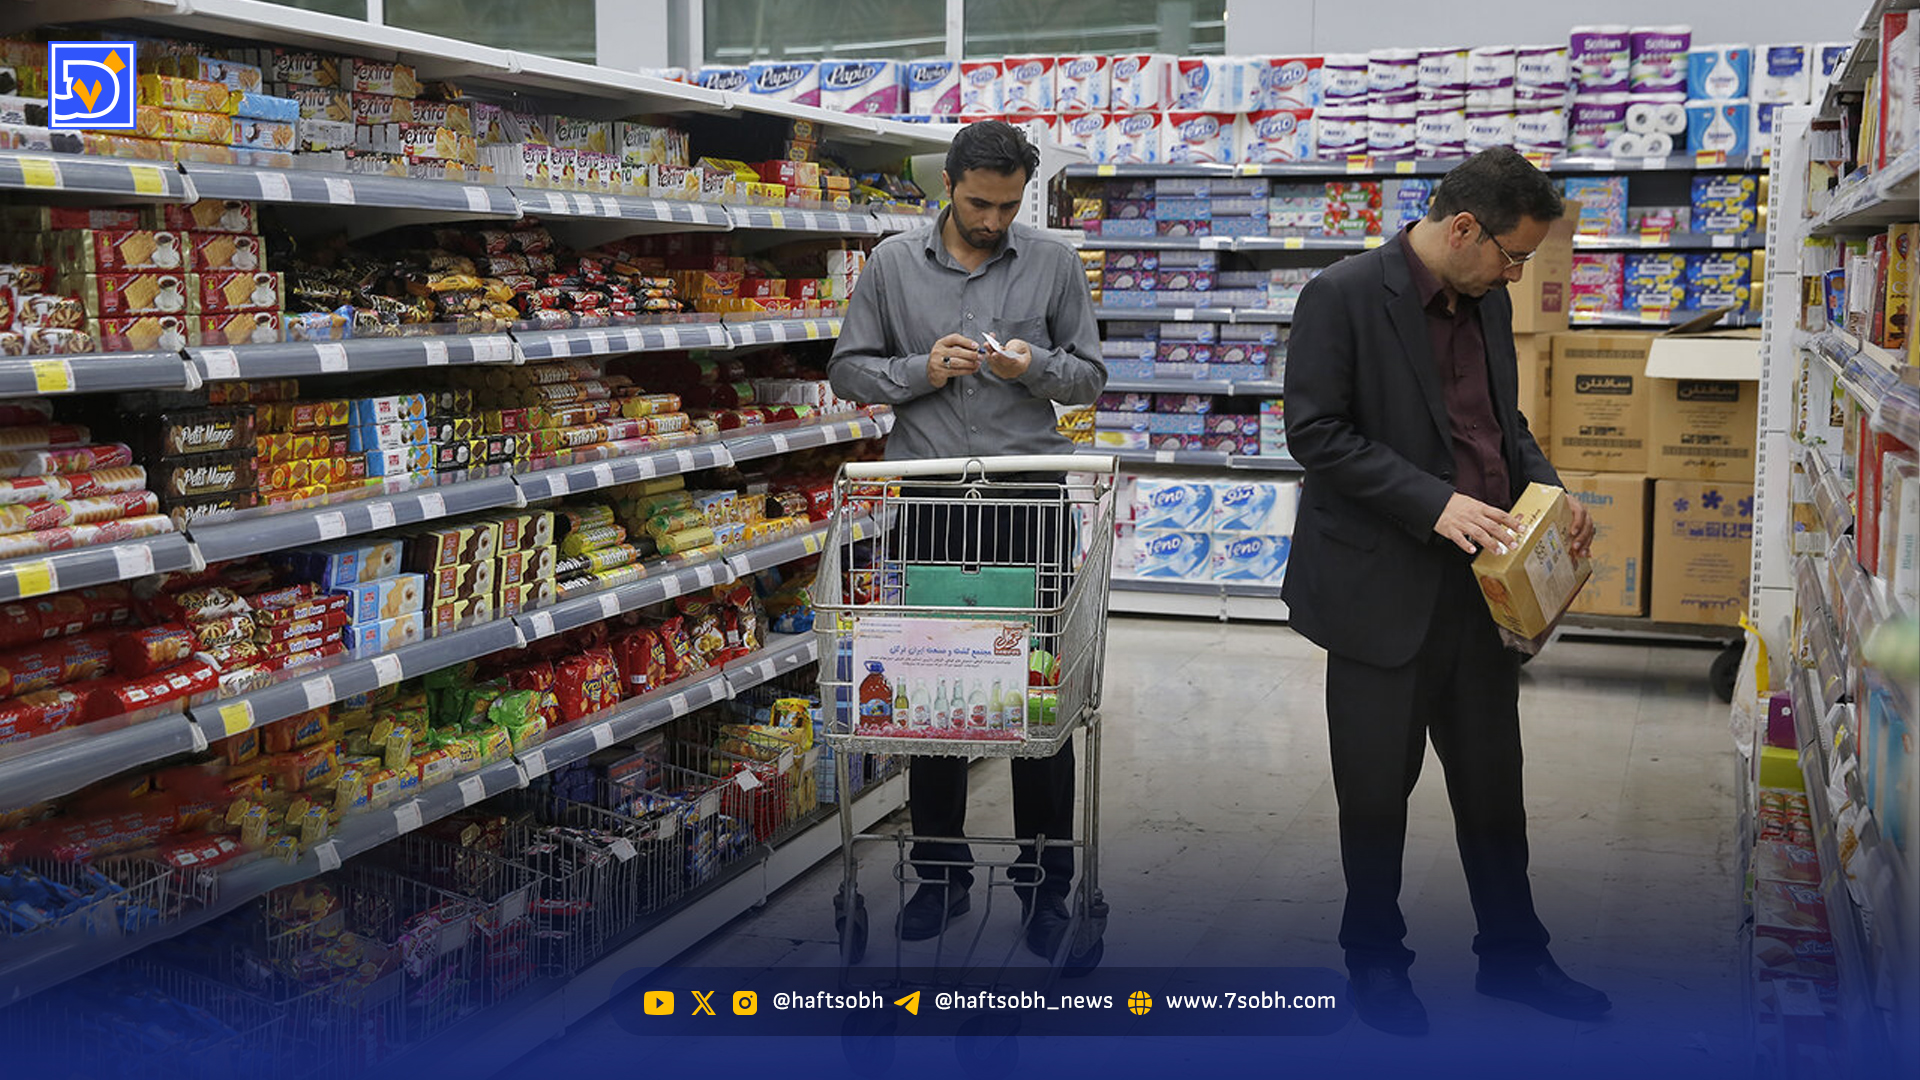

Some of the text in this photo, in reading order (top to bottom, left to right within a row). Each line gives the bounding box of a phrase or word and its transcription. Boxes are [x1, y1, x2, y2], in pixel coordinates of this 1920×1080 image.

[278, 53, 316, 73] extra
[359, 63, 393, 80] extra
[1065, 57, 1095, 78] Teno
[760, 65, 804, 88] Papia
[828, 63, 875, 86] Papia
[916, 65, 948, 82] Papia
[358, 97, 392, 115] extra
[412, 104, 446, 122] extra
[558, 123, 588, 142] extra
[1120, 114, 1150, 134] Teno
[1179, 118, 1213, 141] Teno
[1256, 117, 1291, 139] Teno
[405, 130, 435, 146] extra
[660, 170, 686, 188] extra
[1149, 487, 1185, 508] Teno
[1146, 533, 1182, 556] Teno
[1225, 537, 1262, 559] Teno
[203, 630, 238, 646] Record
